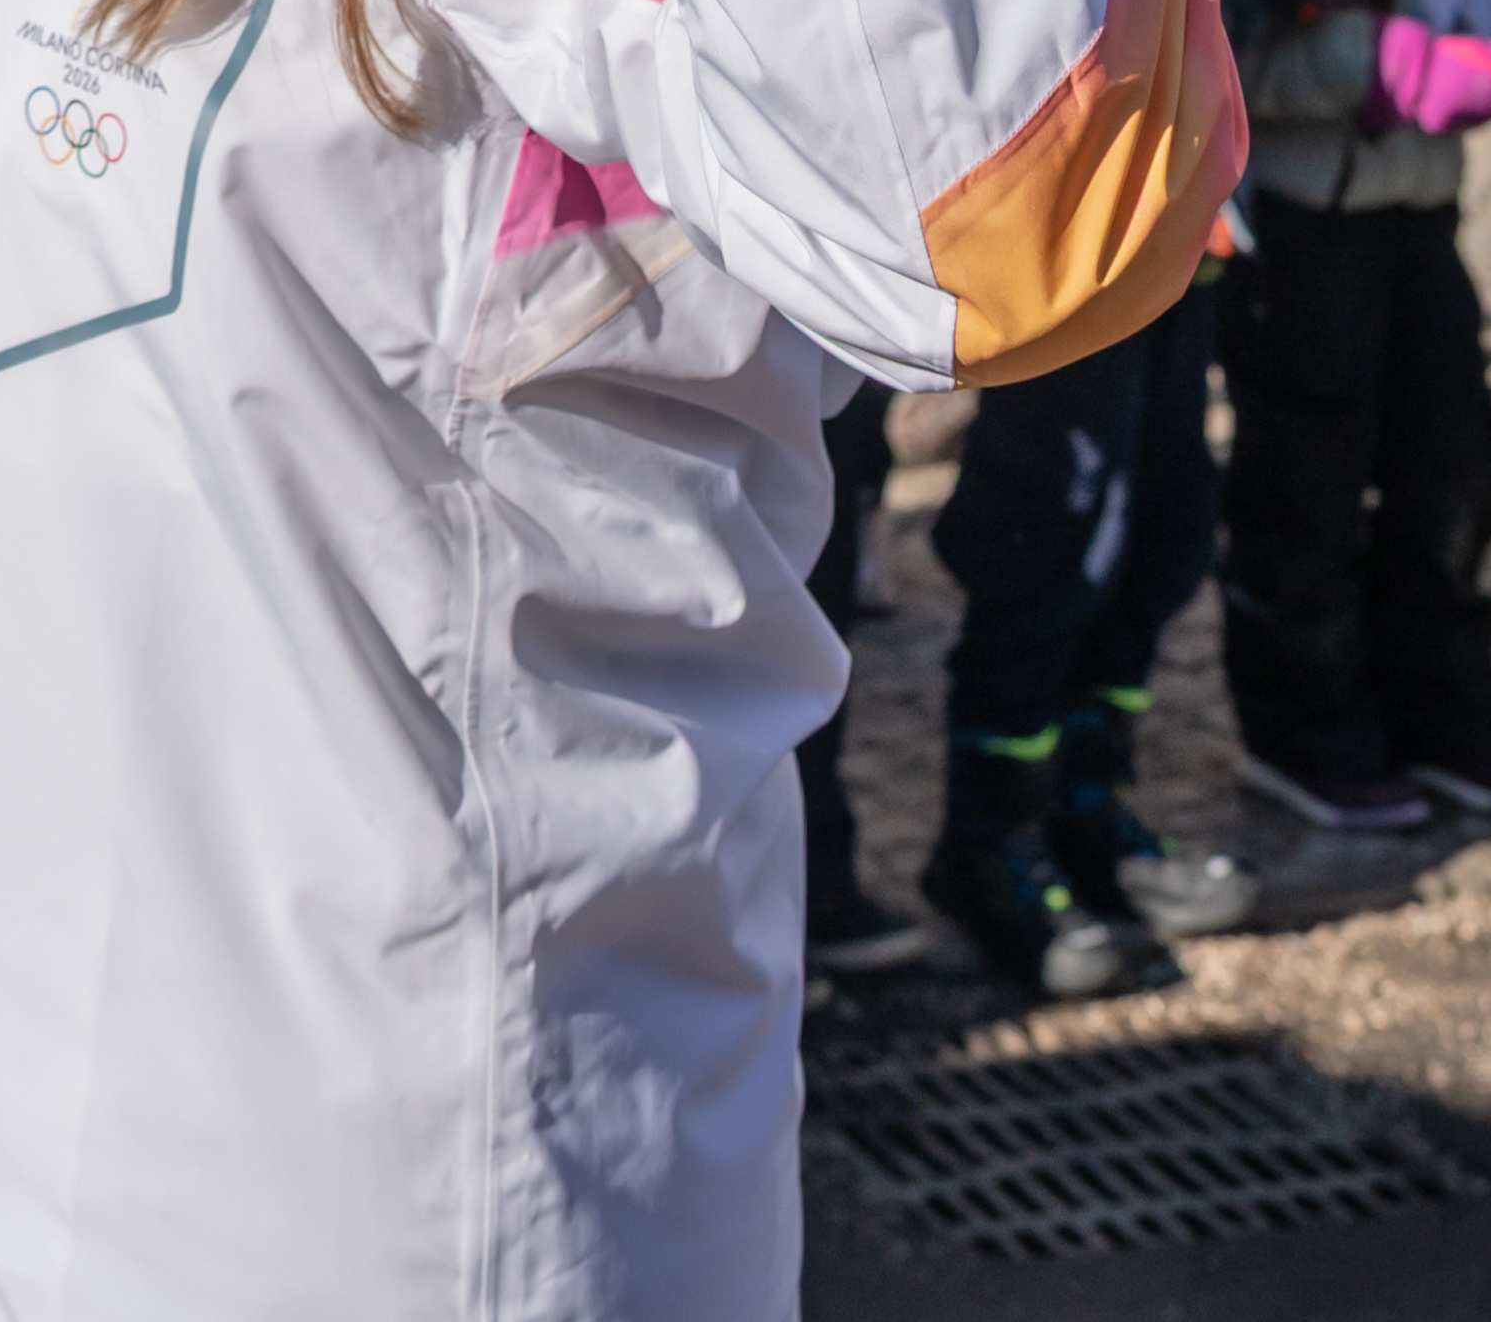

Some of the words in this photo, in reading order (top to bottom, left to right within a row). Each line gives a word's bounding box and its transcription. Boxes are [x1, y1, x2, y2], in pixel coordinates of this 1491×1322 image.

[16, 20, 82, 61] MILANO
[84, 45, 168, 95] CORTINA
[62, 63, 102, 96] 2026
